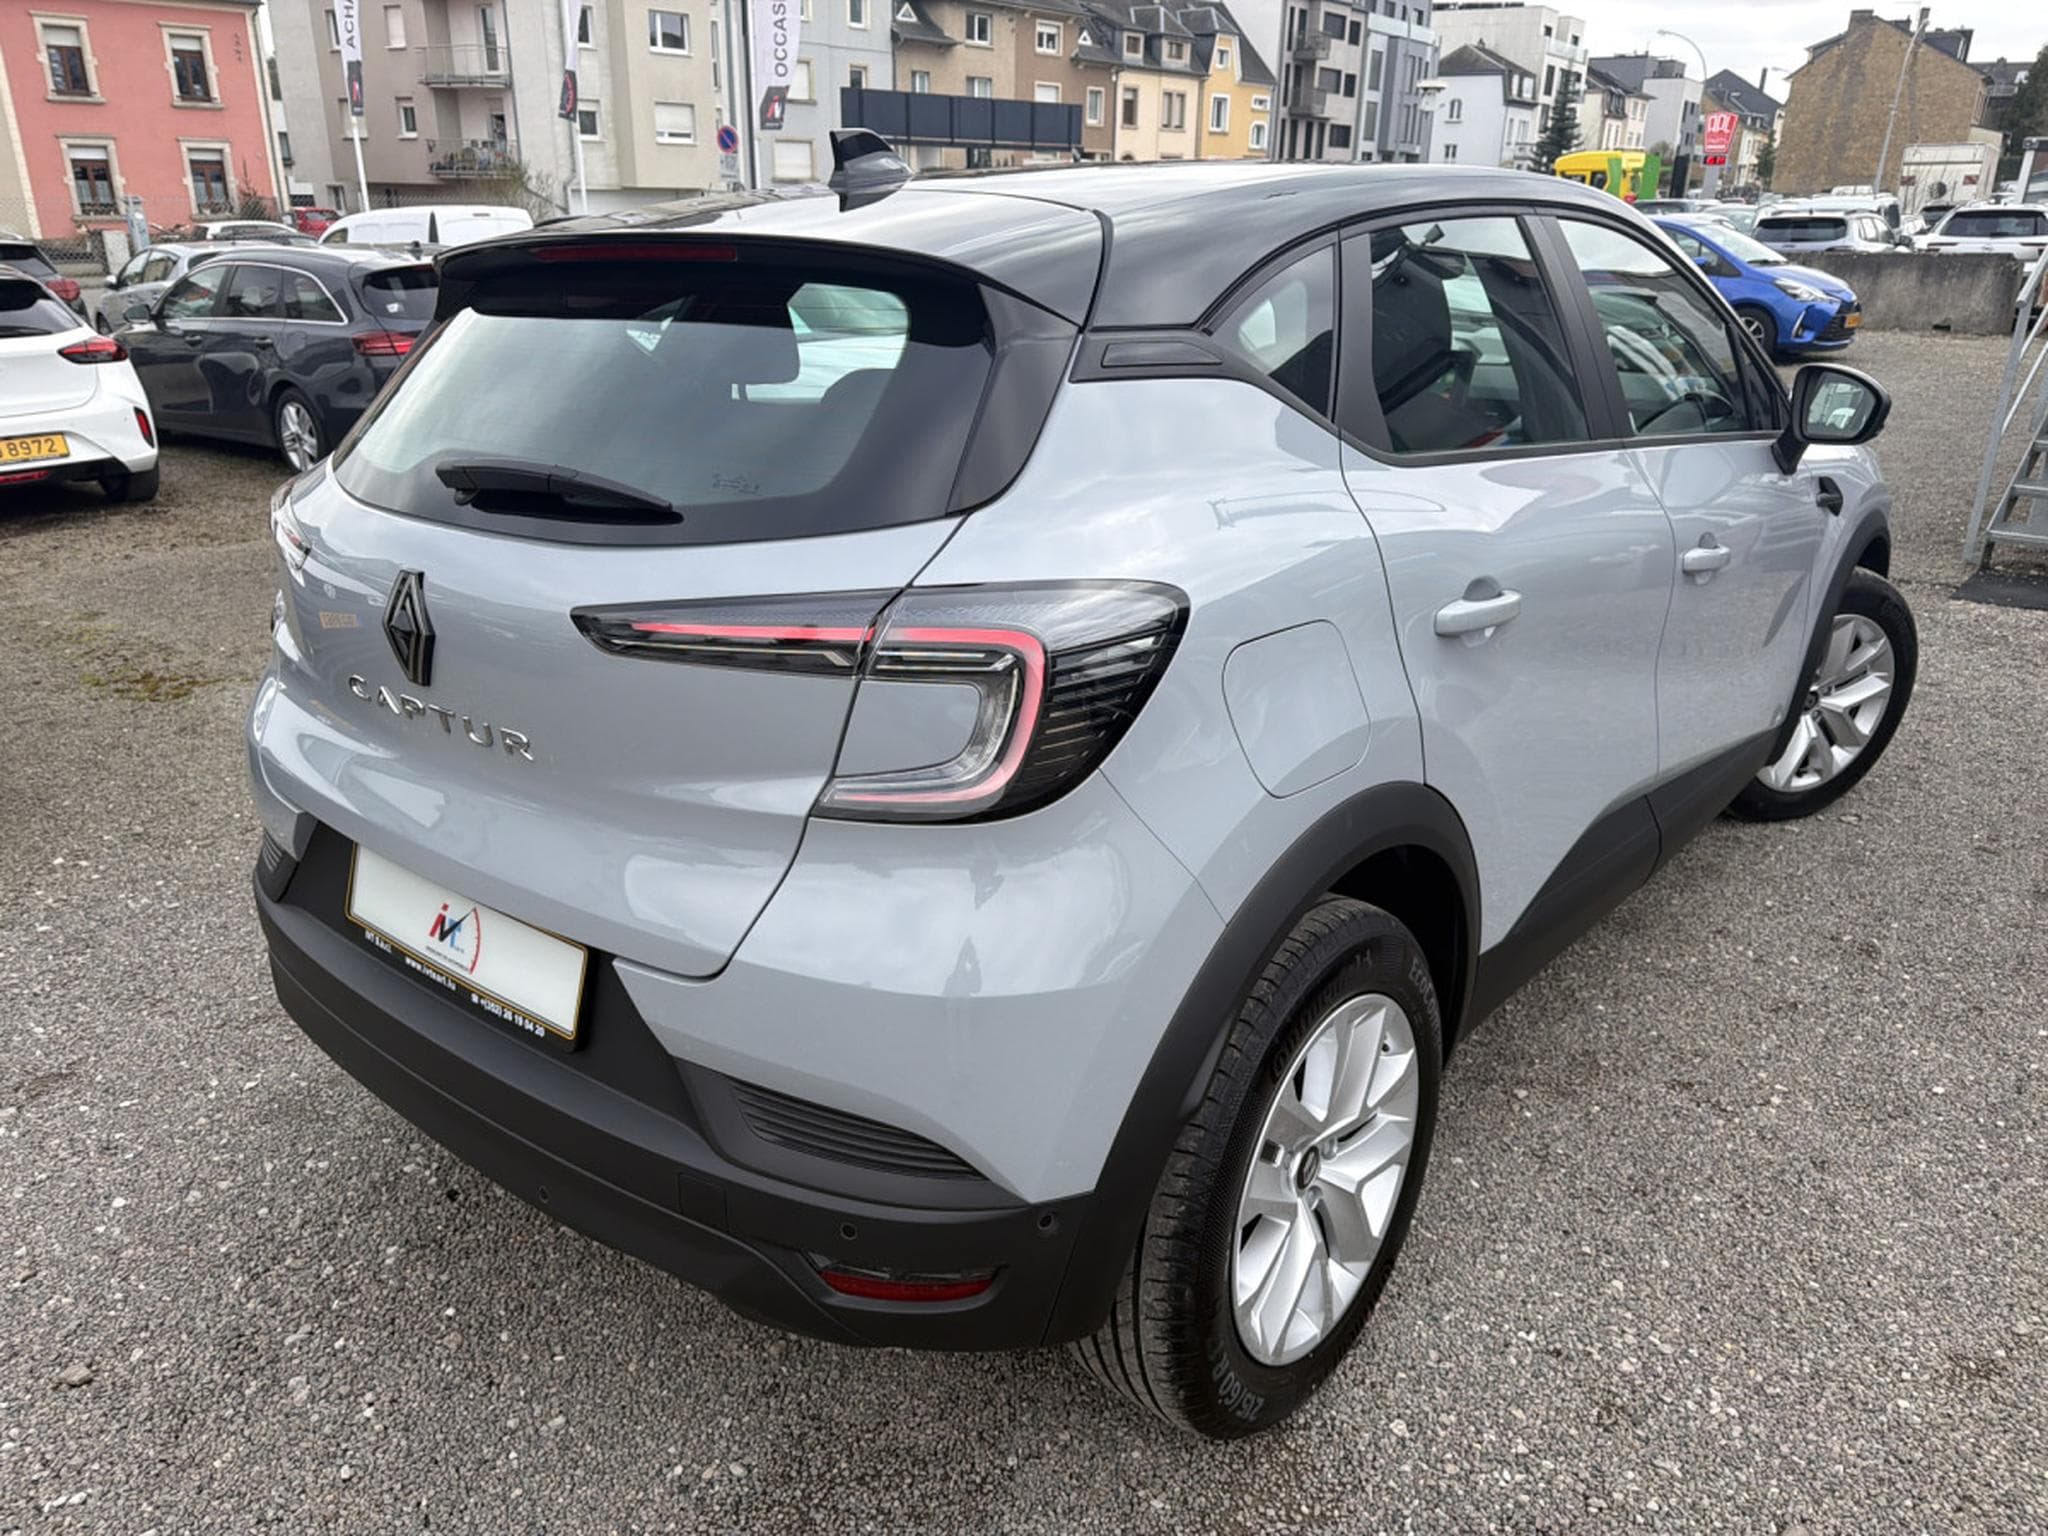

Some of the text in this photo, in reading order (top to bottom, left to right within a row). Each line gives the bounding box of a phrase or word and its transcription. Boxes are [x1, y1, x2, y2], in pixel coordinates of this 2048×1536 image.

[773, 0, 788, 77] OCCAS
[6, 438, 57, 457] 8972
[348, 673, 534, 760] CAPTUR
